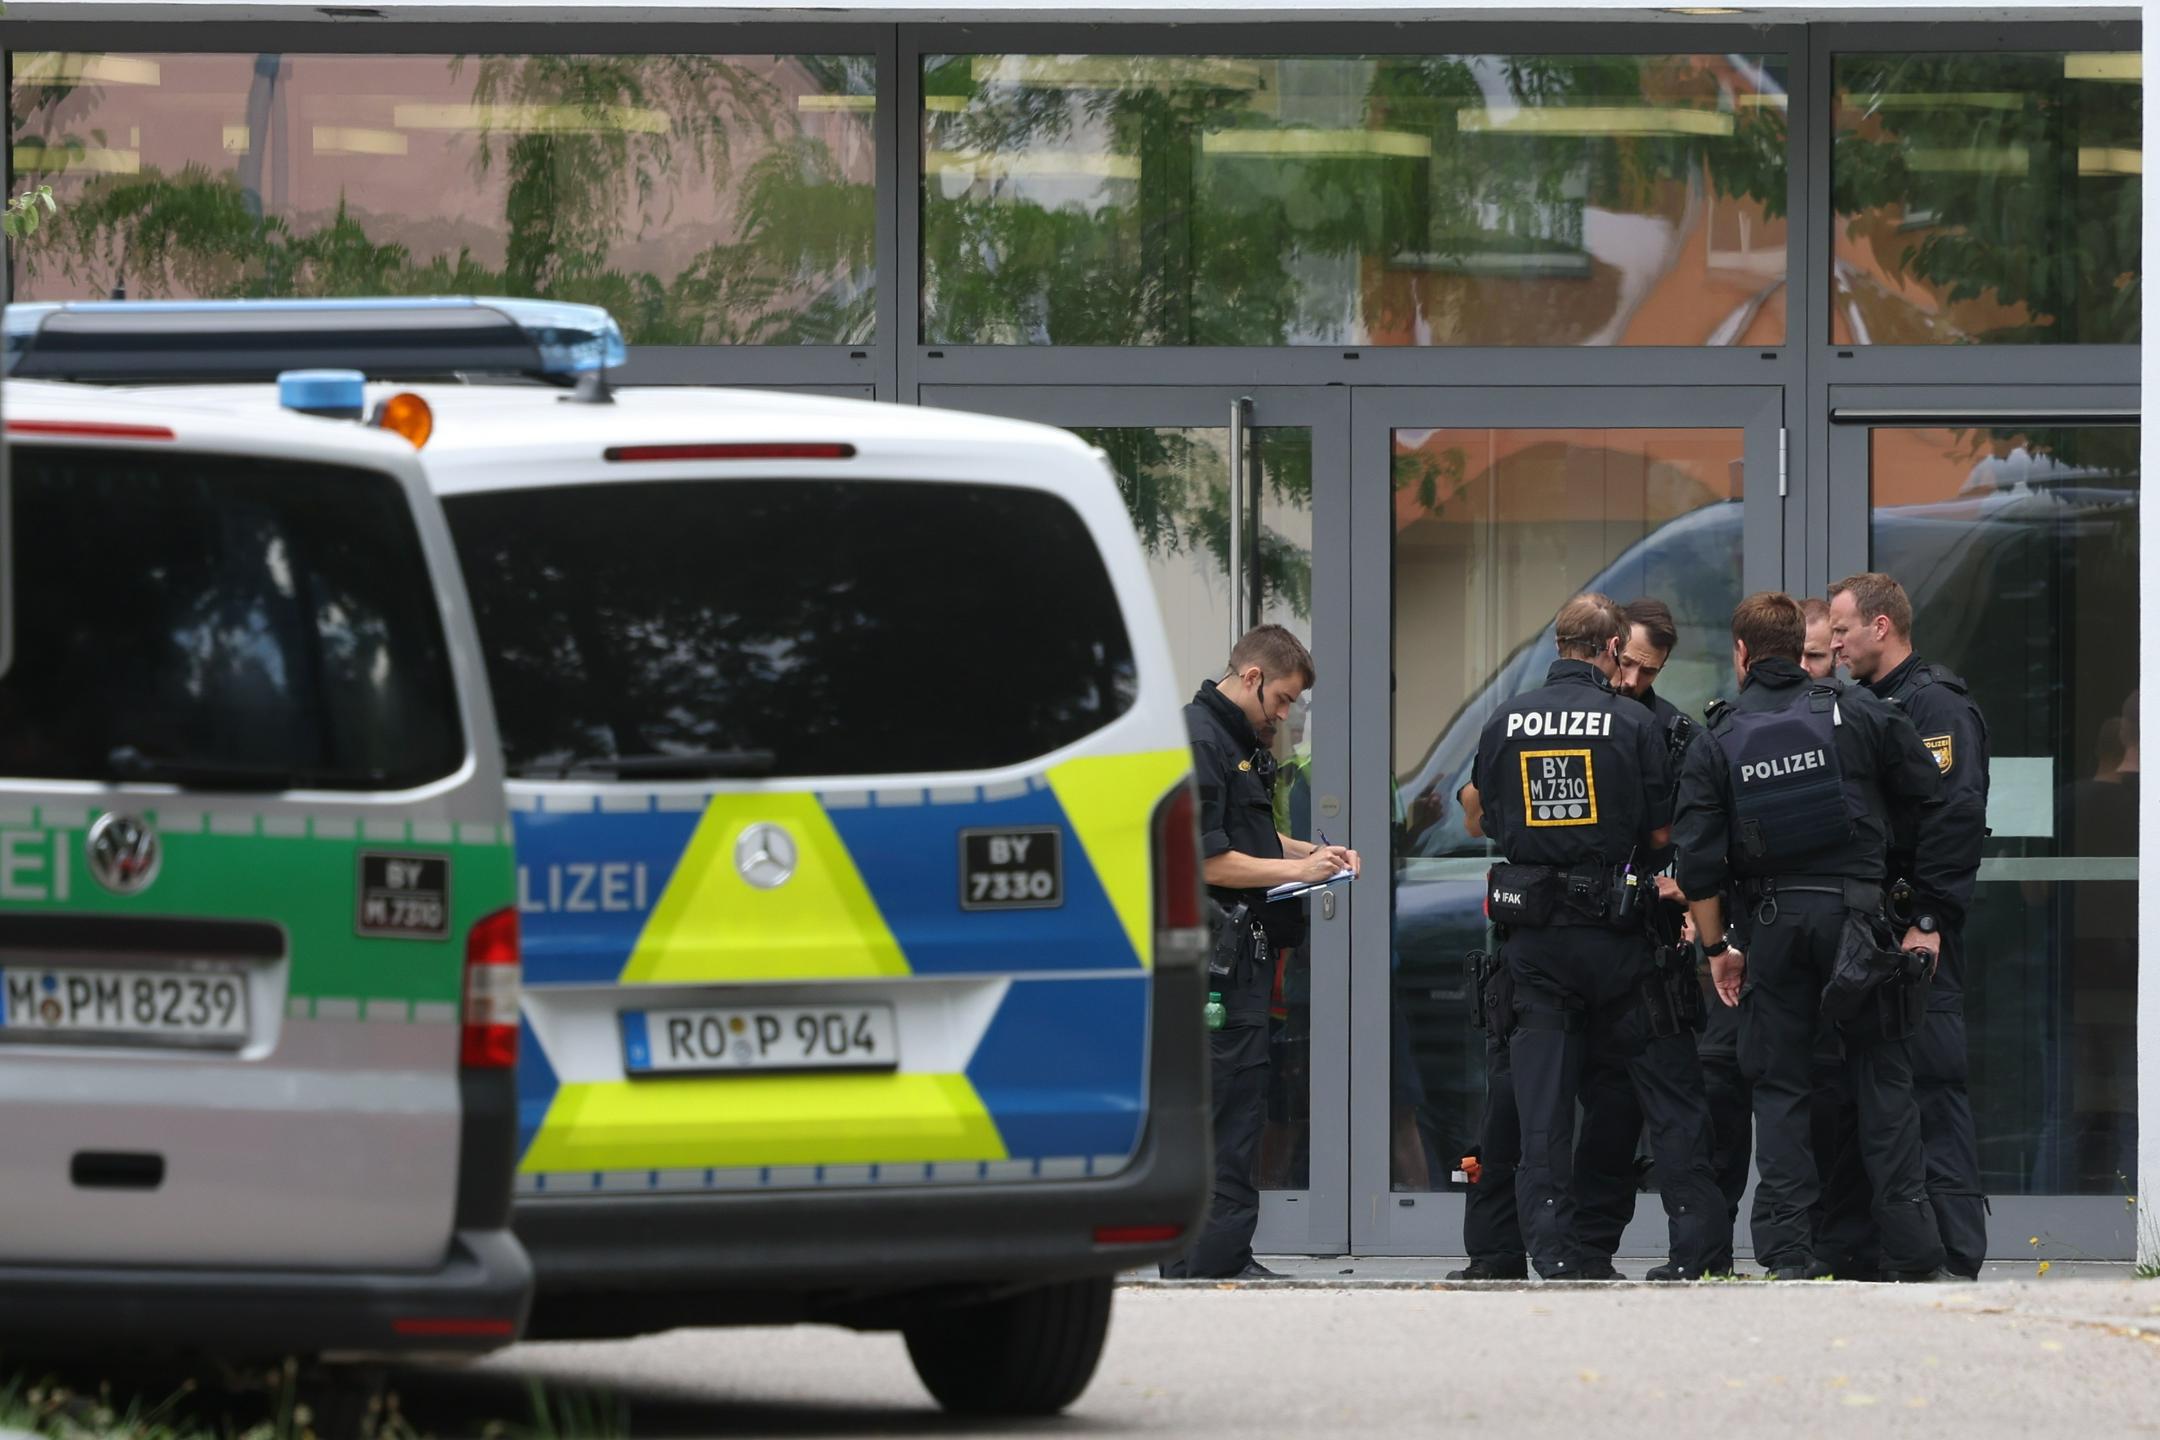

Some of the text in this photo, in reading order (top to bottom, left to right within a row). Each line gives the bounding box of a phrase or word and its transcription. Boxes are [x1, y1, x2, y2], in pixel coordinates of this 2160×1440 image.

[1507, 711, 1612, 737] POLIZEI
[1543, 757, 1570, 778] BY
[1741, 749, 1826, 782] POLIZEI
[1530, 777, 1586, 800] M 7310
[990, 836, 1031, 864] BY
[386, 861, 422, 888] BY
[518, 863, 647, 912] LIZEI
[971, 871, 1053, 900] 7330
[1502, 891, 1521, 904] IFAK
[365, 900, 441, 928] M 7310
[8, 974, 237, 1027] M PM 8239
[668, 1012, 874, 1058] RO P 904
